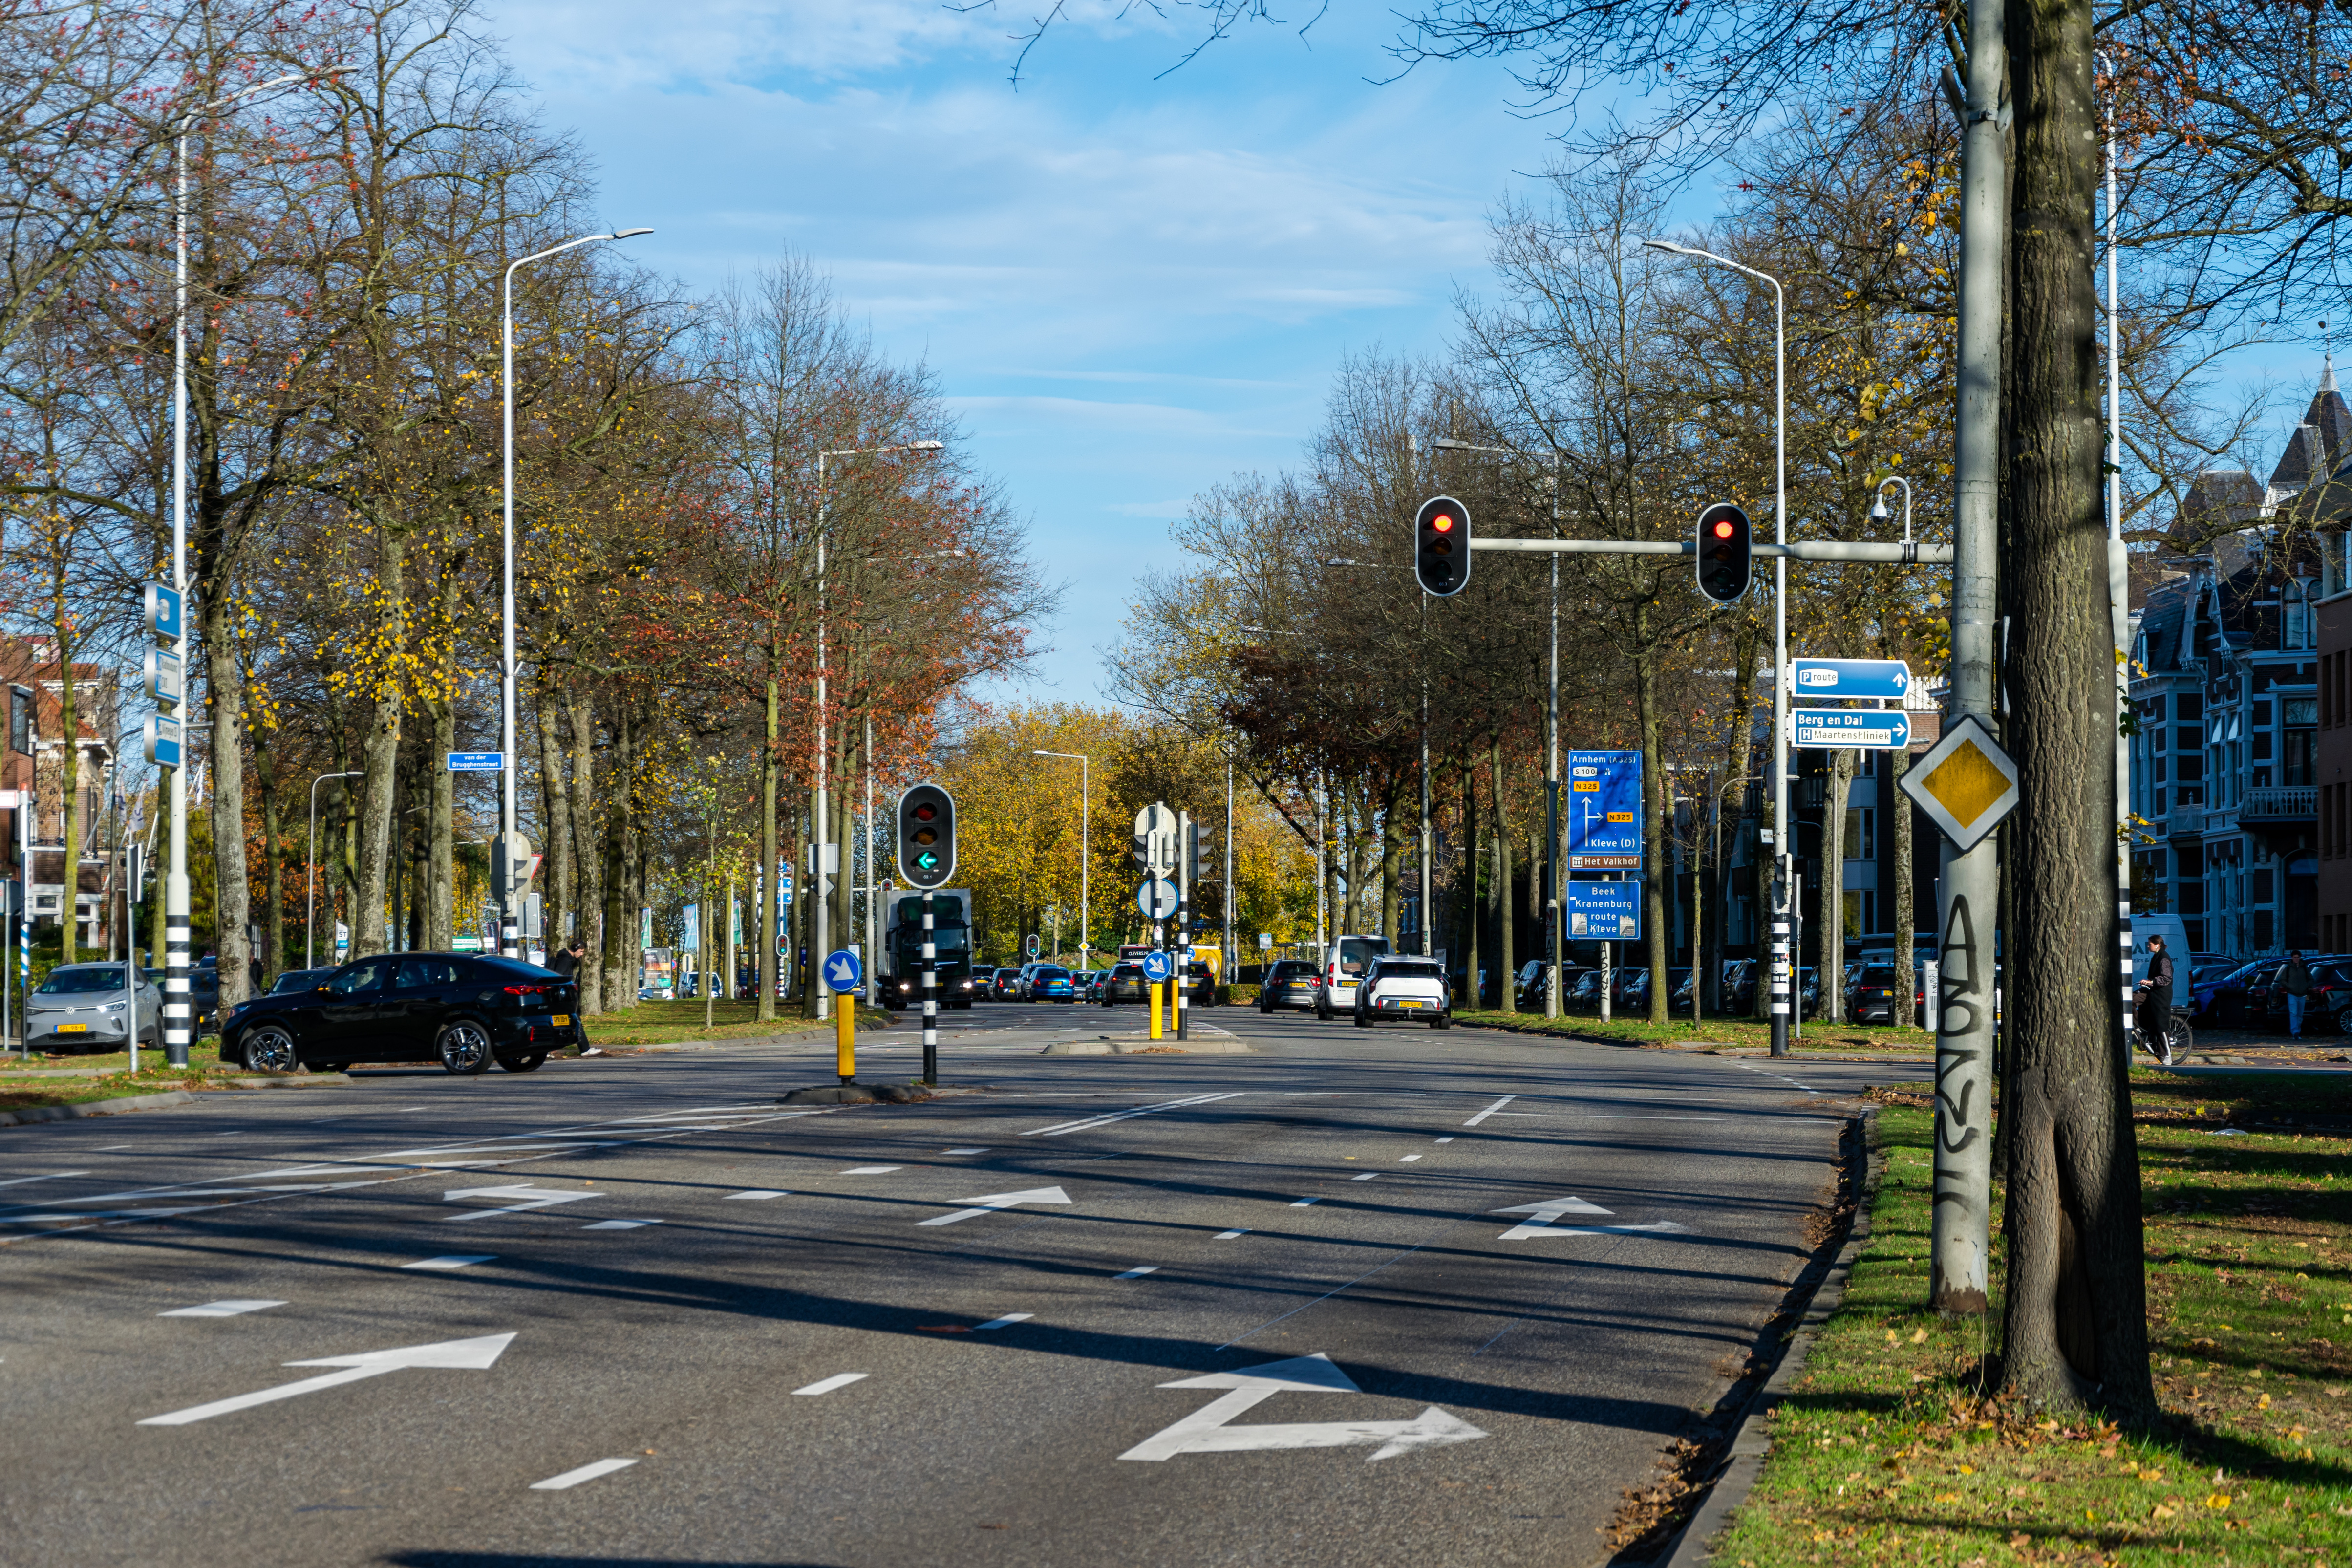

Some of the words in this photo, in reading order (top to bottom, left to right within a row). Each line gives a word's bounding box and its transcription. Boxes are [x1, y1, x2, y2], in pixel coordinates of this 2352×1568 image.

[1798, 714, 1823, 727] Berg
[1845, 715, 1862, 726] Dal
[1621, 838, 1635, 848] (D)
[1603, 857, 1637, 865] Valkhof
[1592, 887, 1615, 895] Beek
[1575, 900, 1632, 910] Kranenburg
[1590, 924, 1617, 933] Kleve
